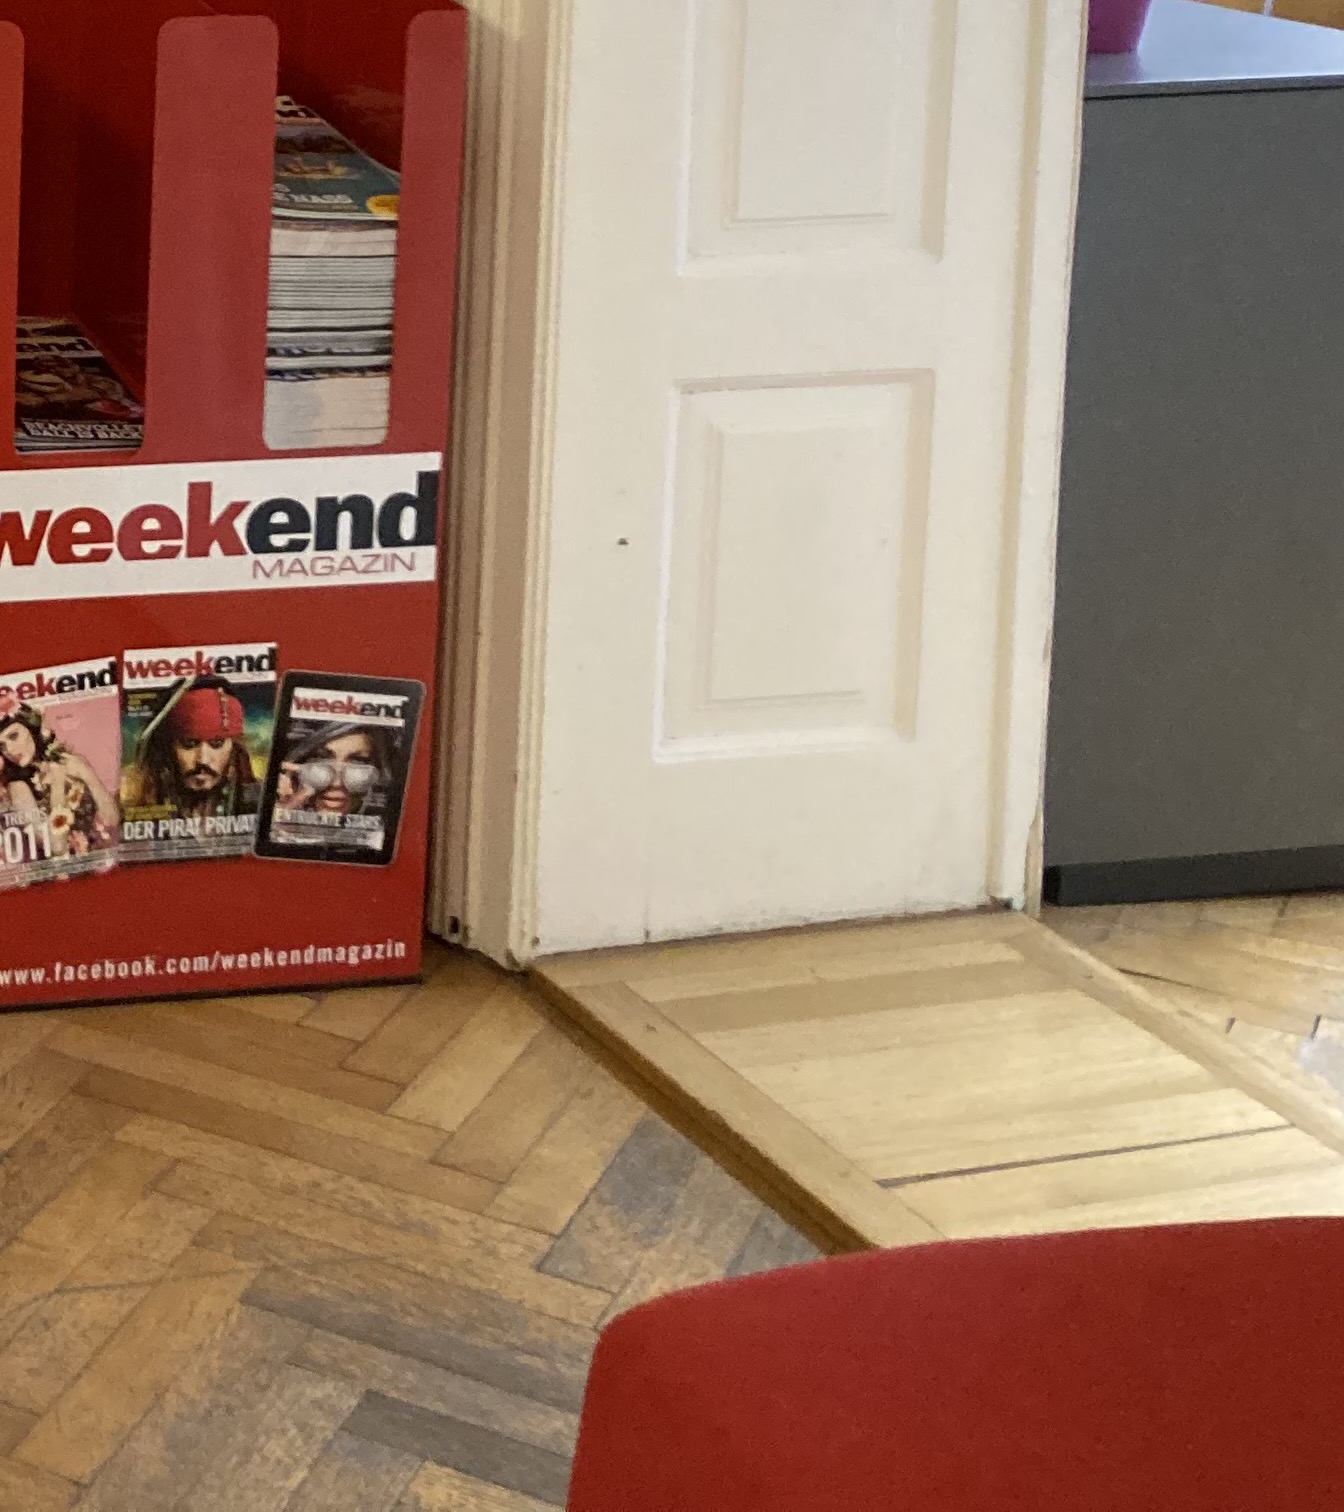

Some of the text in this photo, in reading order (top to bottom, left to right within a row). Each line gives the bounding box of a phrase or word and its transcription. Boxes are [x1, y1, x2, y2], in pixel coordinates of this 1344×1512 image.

[253, 552, 416, 579] MAGAZIN
[124, 646, 277, 679] weekend
[293, 695, 409, 719] weekend
[123, 821, 155, 840] DER
